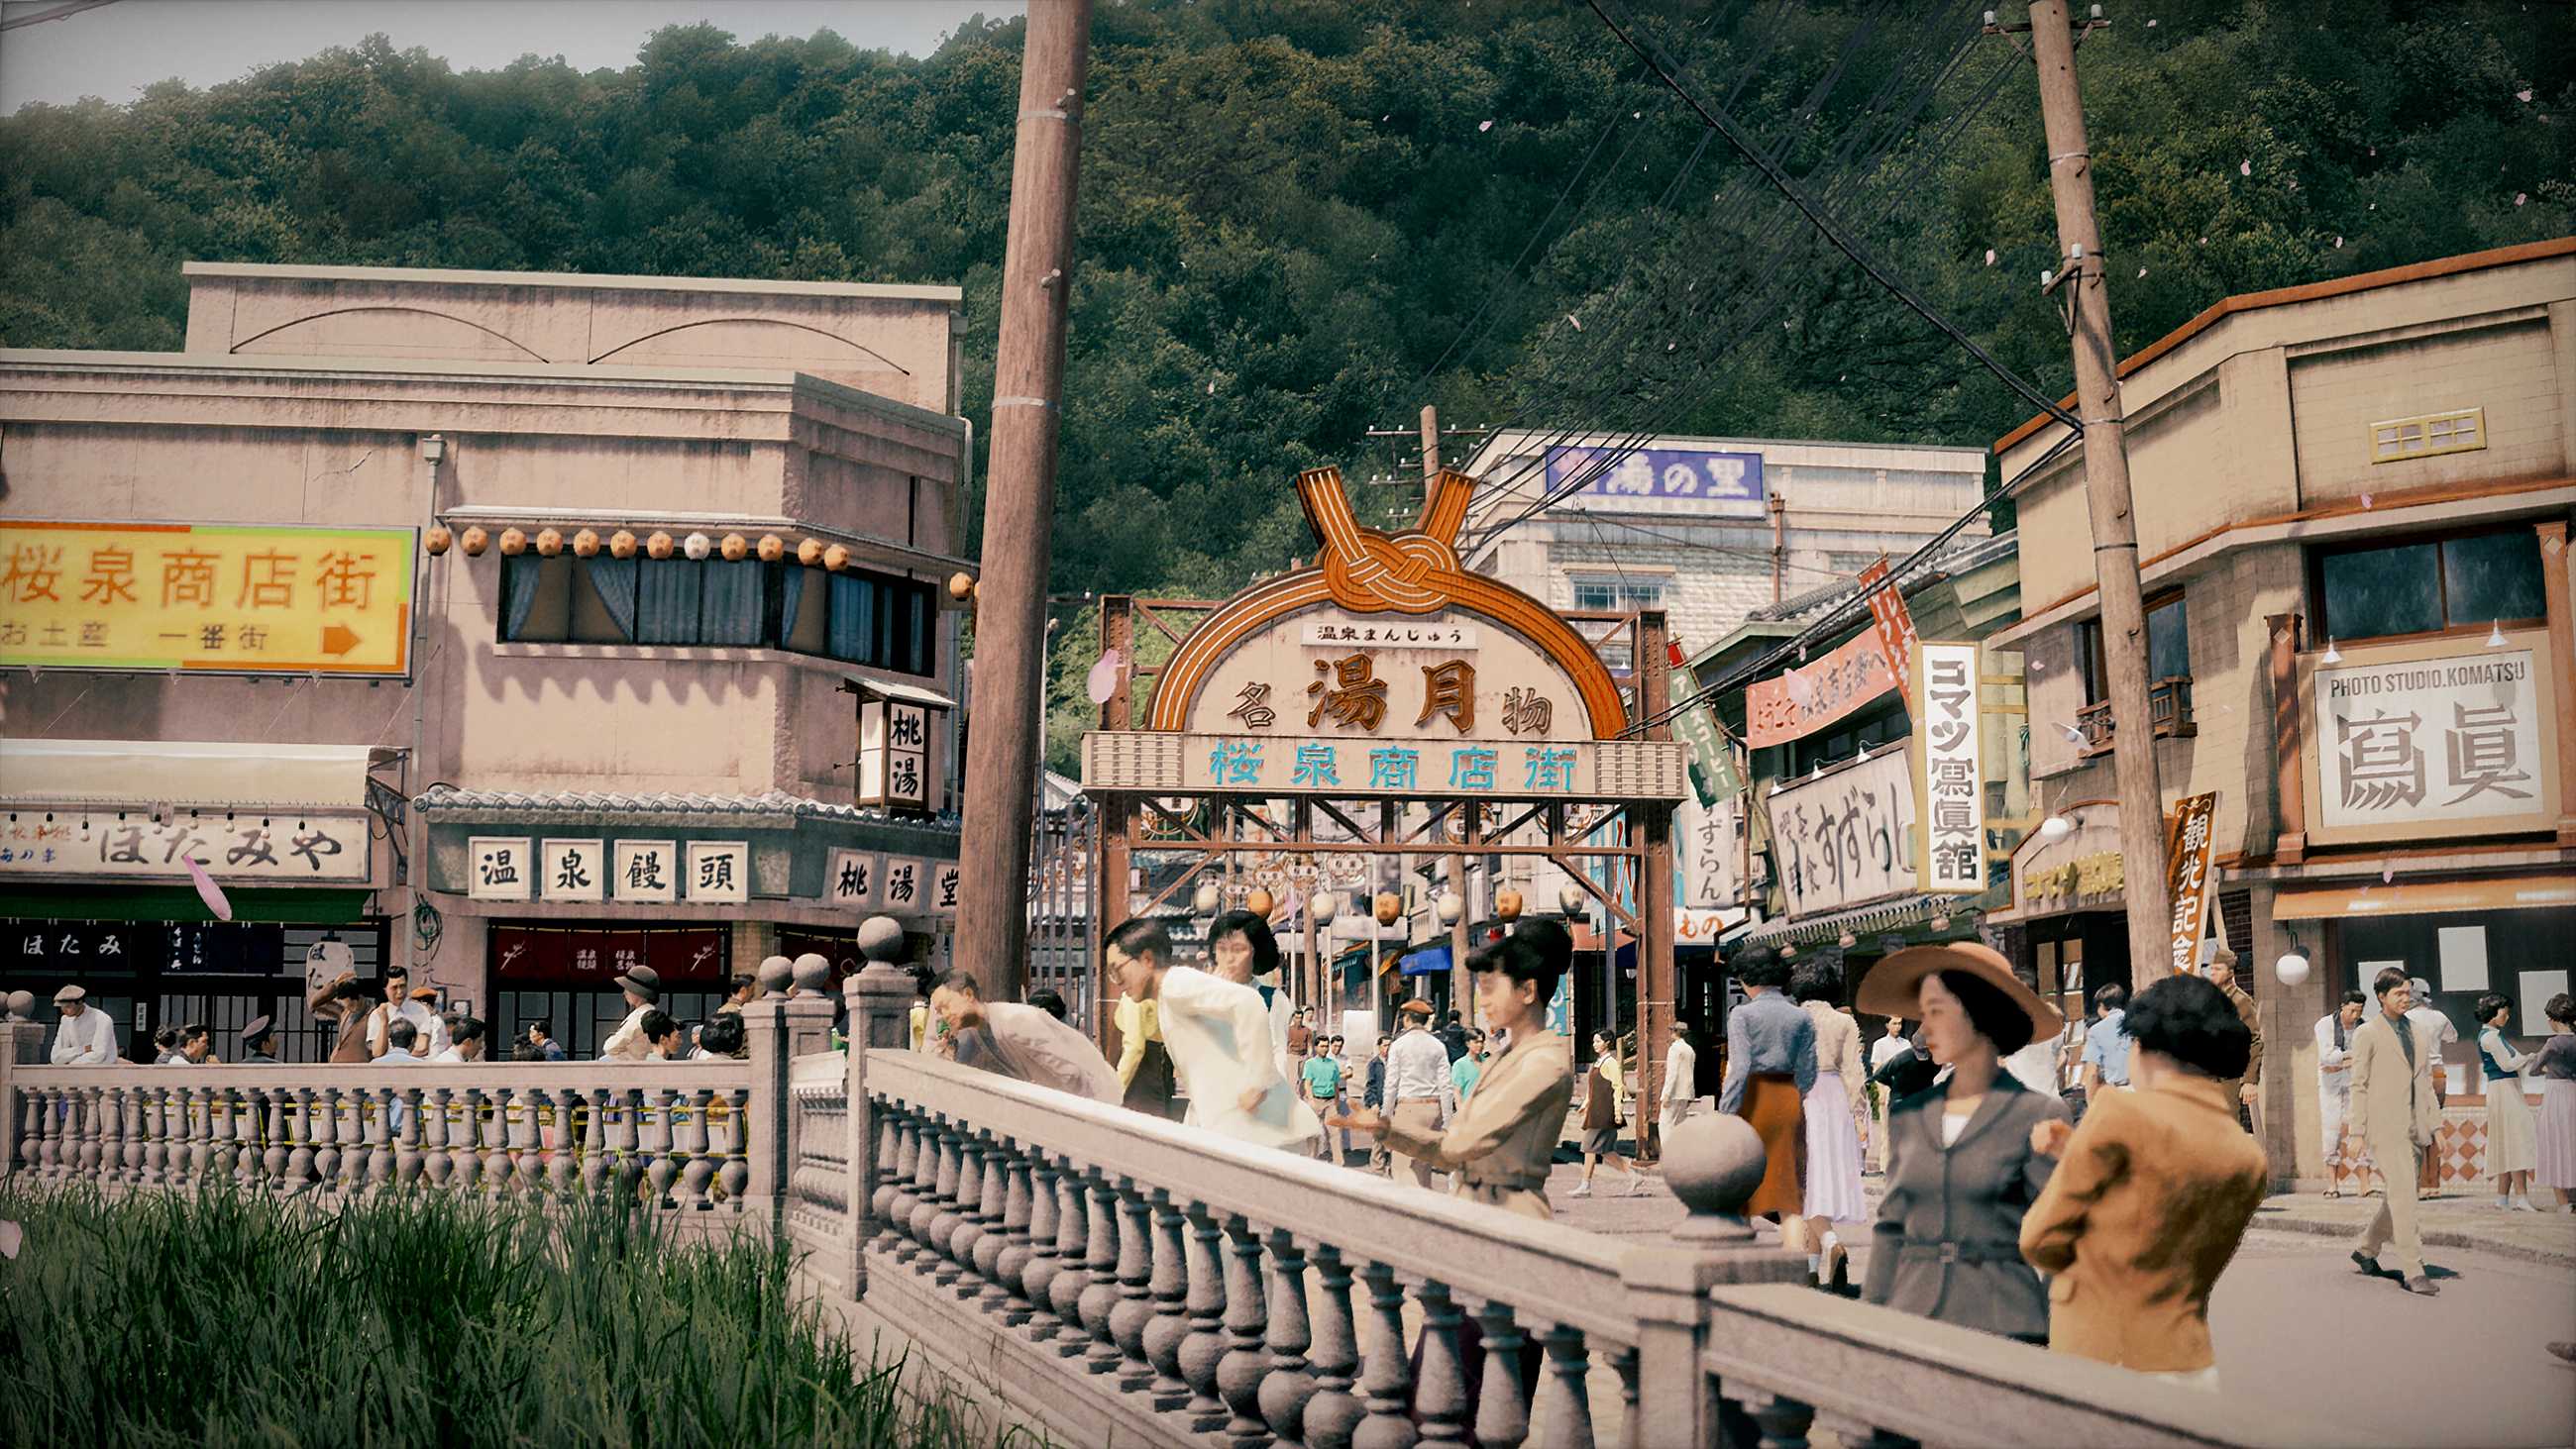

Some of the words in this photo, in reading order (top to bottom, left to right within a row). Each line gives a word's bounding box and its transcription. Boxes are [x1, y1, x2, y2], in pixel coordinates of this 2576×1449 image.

[1, 543, 376, 611] 桜泉商店街
[159, 623, 268, 650] 一番街
[1318, 625, 1461, 643] 温泉まんじゅう
[2330, 674, 2382, 698] PHOTO
[891, 709, 922, 797] 桃湯
[1209, 741, 1577, 791] 桜泉商店街
[100, 827, 342, 872] ほたみや
[480, 848, 735, 891] 温泉饅頭
[837, 860, 959, 907] 桃湯堂
[23, 934, 122, 956] ほたみ
